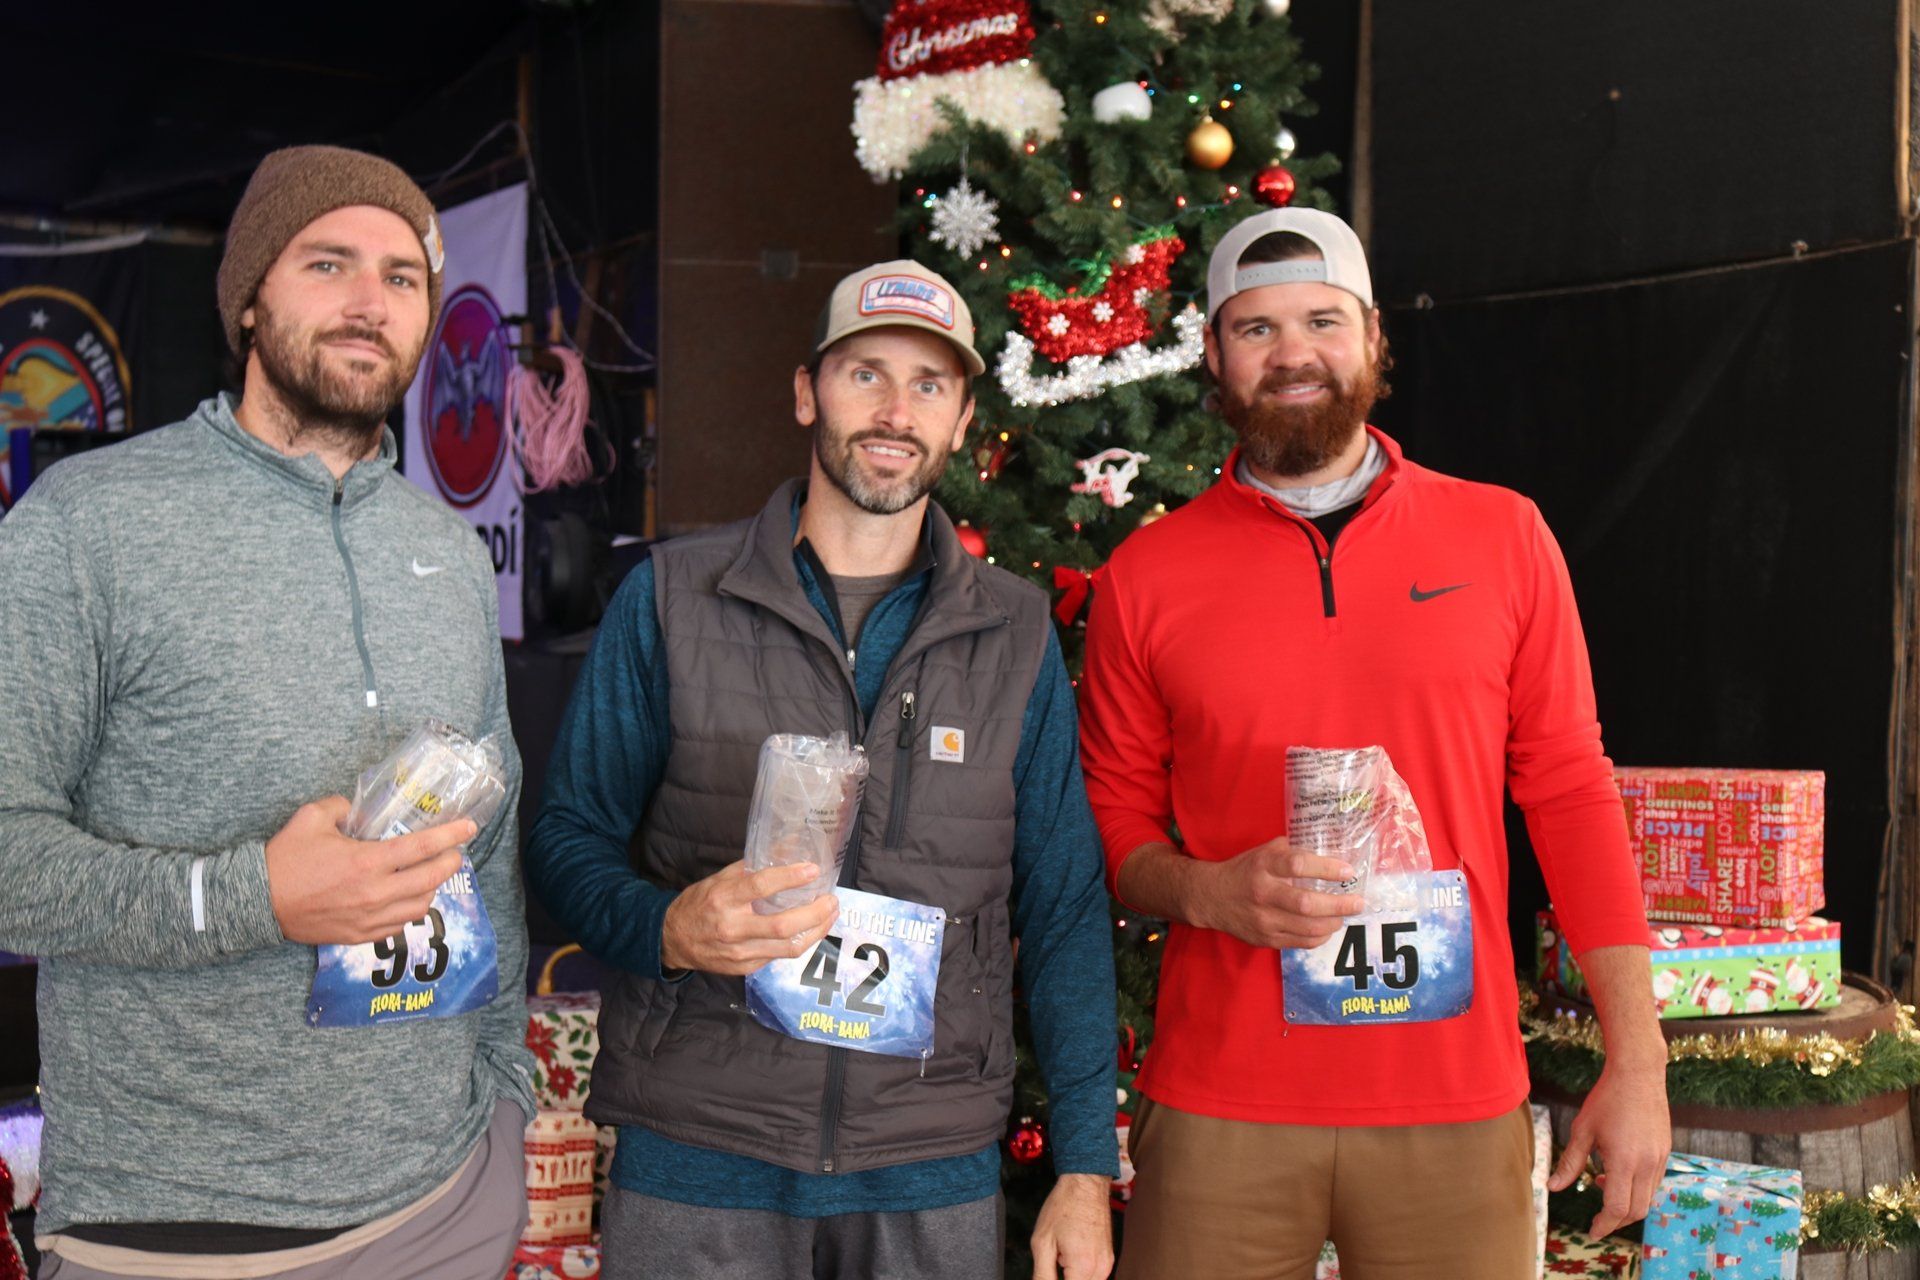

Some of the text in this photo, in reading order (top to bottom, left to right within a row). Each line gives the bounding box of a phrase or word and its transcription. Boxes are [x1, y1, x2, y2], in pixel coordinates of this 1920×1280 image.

[888, 12, 1019, 71] Christmas
[1645, 799, 1715, 811] GREETINGS
[1717, 801, 1733, 844] LOVE
[1645, 820, 1705, 838] PEACE
[1644, 838, 1659, 877] JOY
[1736, 858, 1749, 889] love
[1760, 843, 1776, 884] JOY
[1716, 856, 1734, 915] SHARE
[844, 908, 937, 945] TO THE LINE
[1645, 910, 1714, 924] GREETINGS
[371, 908, 450, 988] 93
[1333, 921, 1420, 991] 45
[799, 934, 890, 1018] 42
[369, 988, 435, 1018] FLORA-BAMA
[1341, 995, 1412, 1017] FLORA-BAMA
[799, 1010, 871, 1040] FLORA-BAMA
